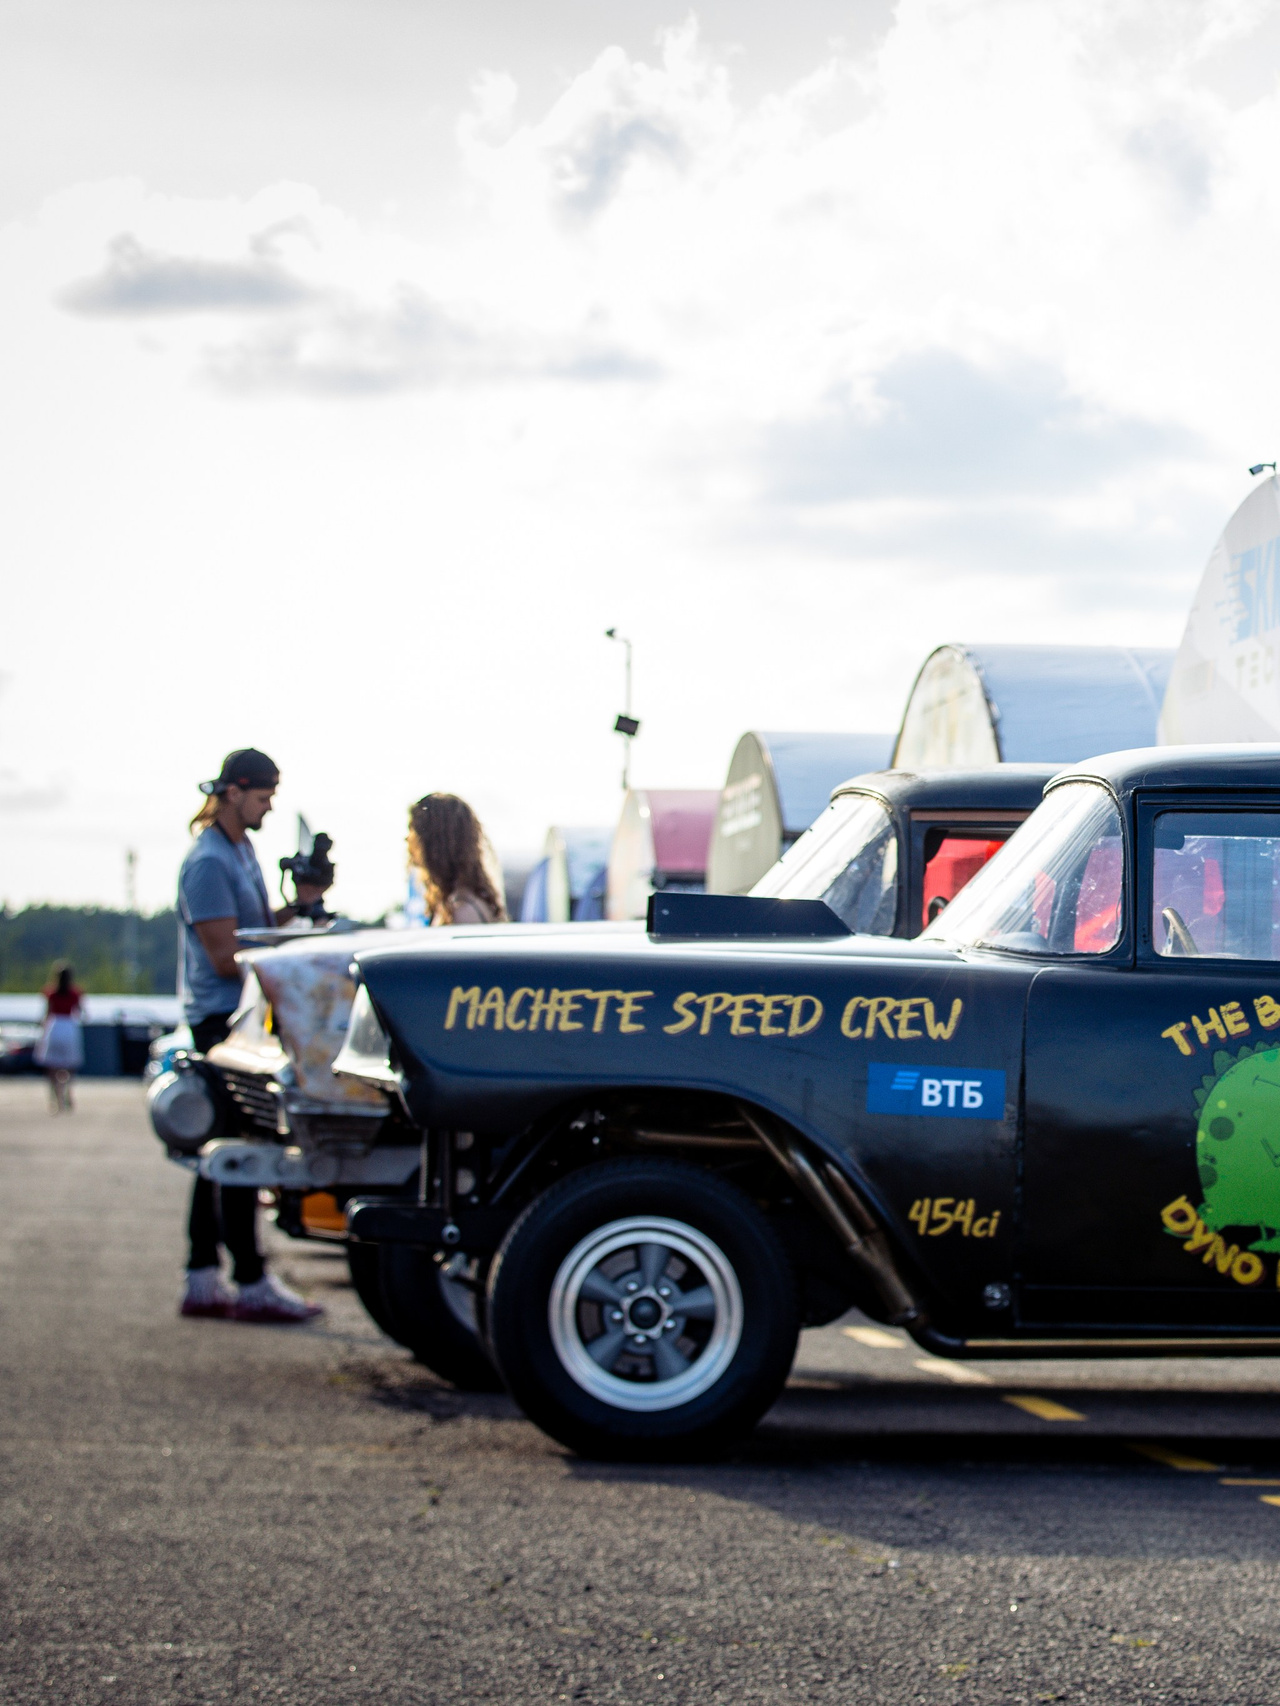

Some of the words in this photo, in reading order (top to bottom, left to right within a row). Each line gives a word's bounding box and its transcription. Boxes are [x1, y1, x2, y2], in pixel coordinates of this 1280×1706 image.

[445, 986, 654, 1033] MACHETE
[663, 992, 824, 1039] SPEED
[840, 996, 963, 1040] CREW
[1161, 1002, 1250, 1055] THE
[921, 1078, 984, 1108] ВТБ
[908, 1197, 1001, 1238] 454ci
[1161, 1195, 1264, 1285] DYNO
